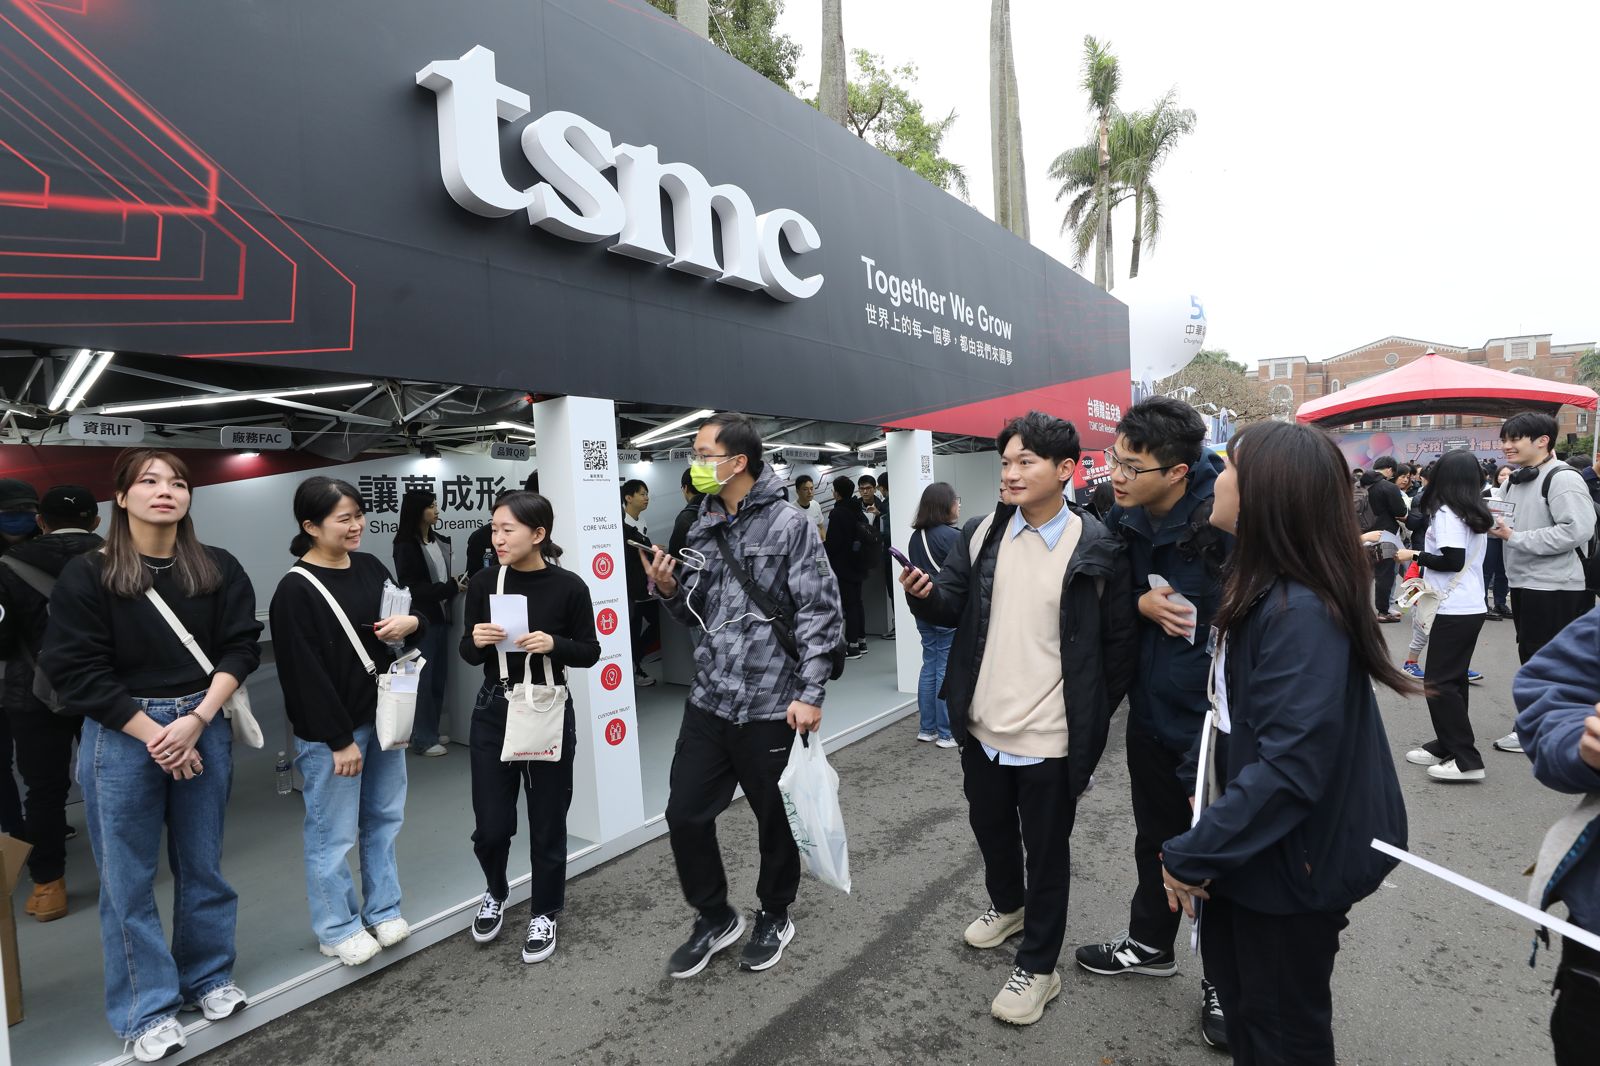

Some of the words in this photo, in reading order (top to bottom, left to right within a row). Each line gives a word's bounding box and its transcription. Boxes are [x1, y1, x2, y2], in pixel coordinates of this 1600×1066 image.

[416, 44, 825, 303] tsmc
[861, 255, 946, 316] Together
[949, 291, 974, 326] We
[977, 305, 1012, 340] Grow
[83, 421, 132, 436] 資訊IT
[232, 431, 282, 444] 廠務FAC
[497, 446, 525, 457] 品質QR
[434, 518, 484, 531] Dreams
[598, 523, 617, 531] VALUES
[599, 653, 622, 662] NNOVATION
[597, 709, 618, 719] CUSTOMER
[619, 705, 630, 714] TRUST
